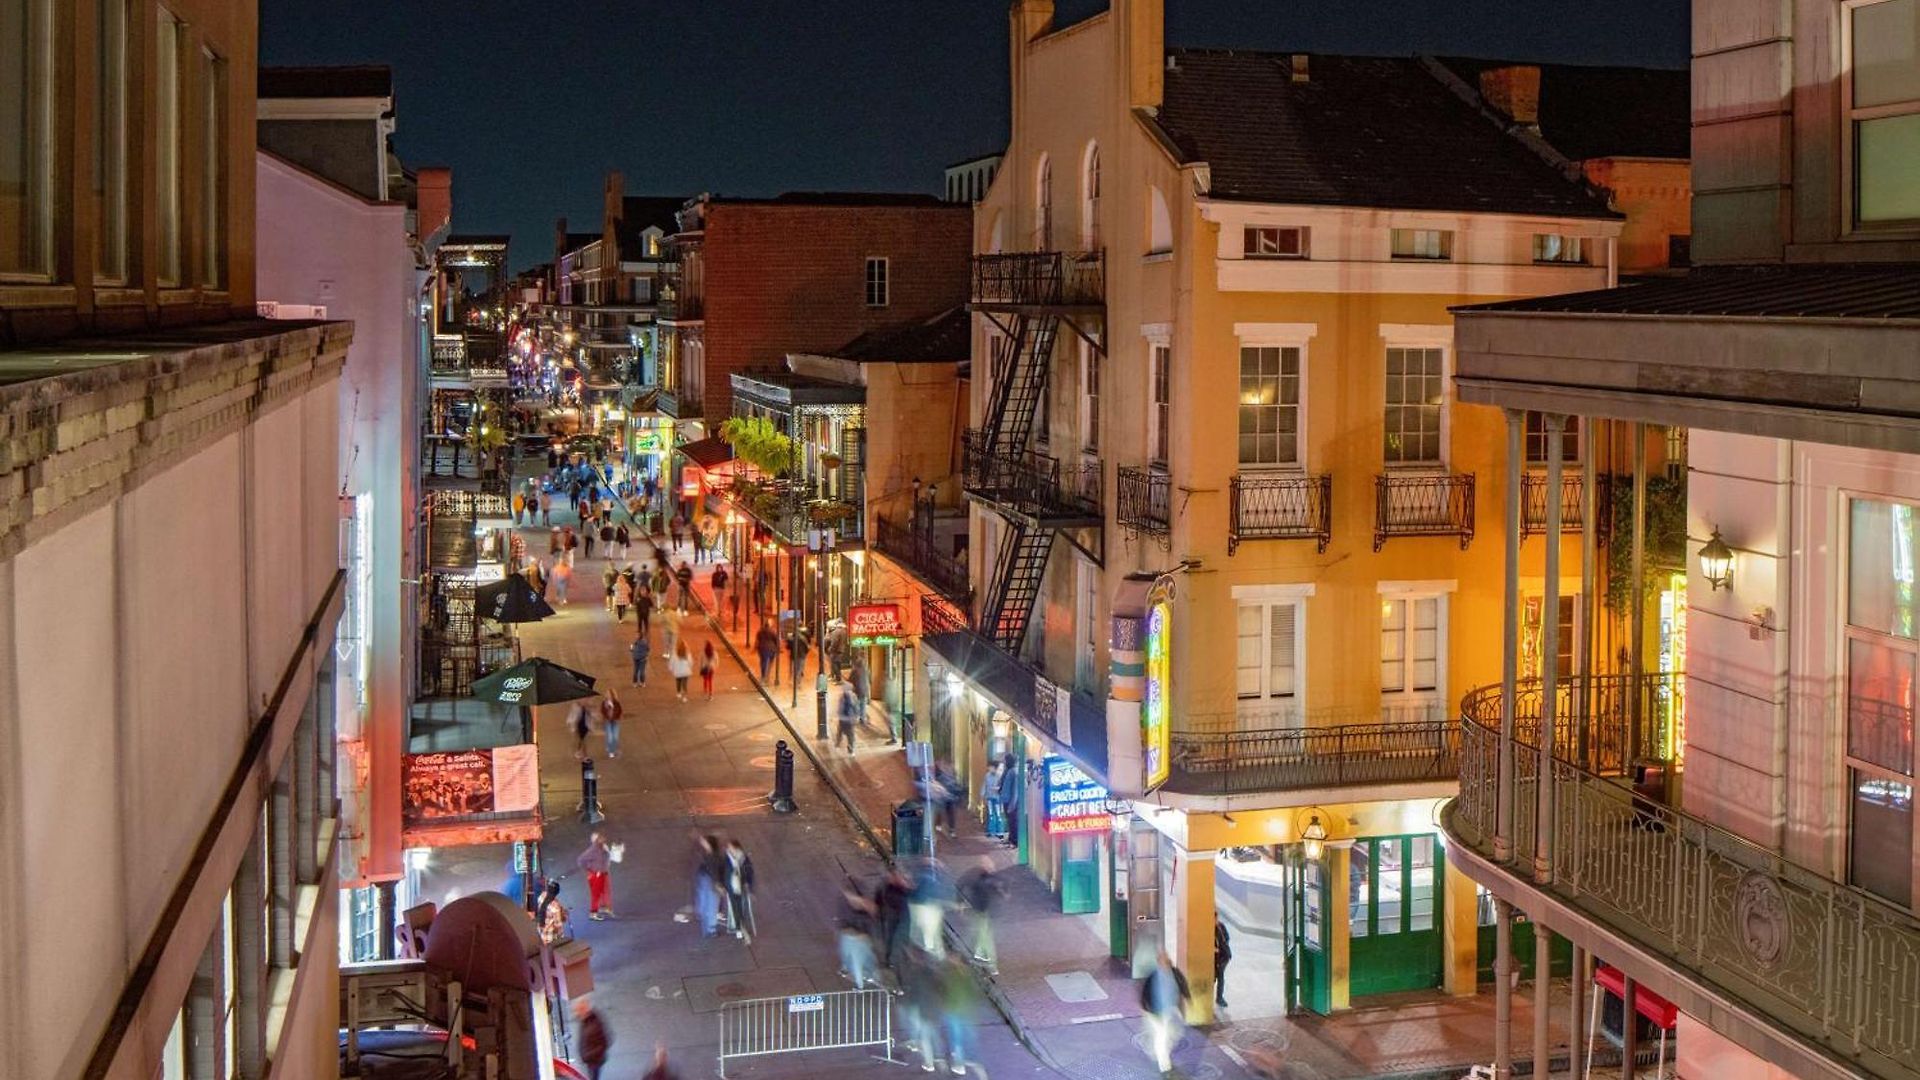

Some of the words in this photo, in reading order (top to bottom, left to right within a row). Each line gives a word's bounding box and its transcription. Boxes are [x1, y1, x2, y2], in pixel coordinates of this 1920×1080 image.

[855, 612, 894, 624] CIGAR
[852, 623, 897, 634] FACTORY
[410, 765, 439, 773] Always
[1050, 790, 1078, 803] FROZEN
[1057, 801, 1086, 817] CRAFT
[1088, 799, 1107, 814] BEE
